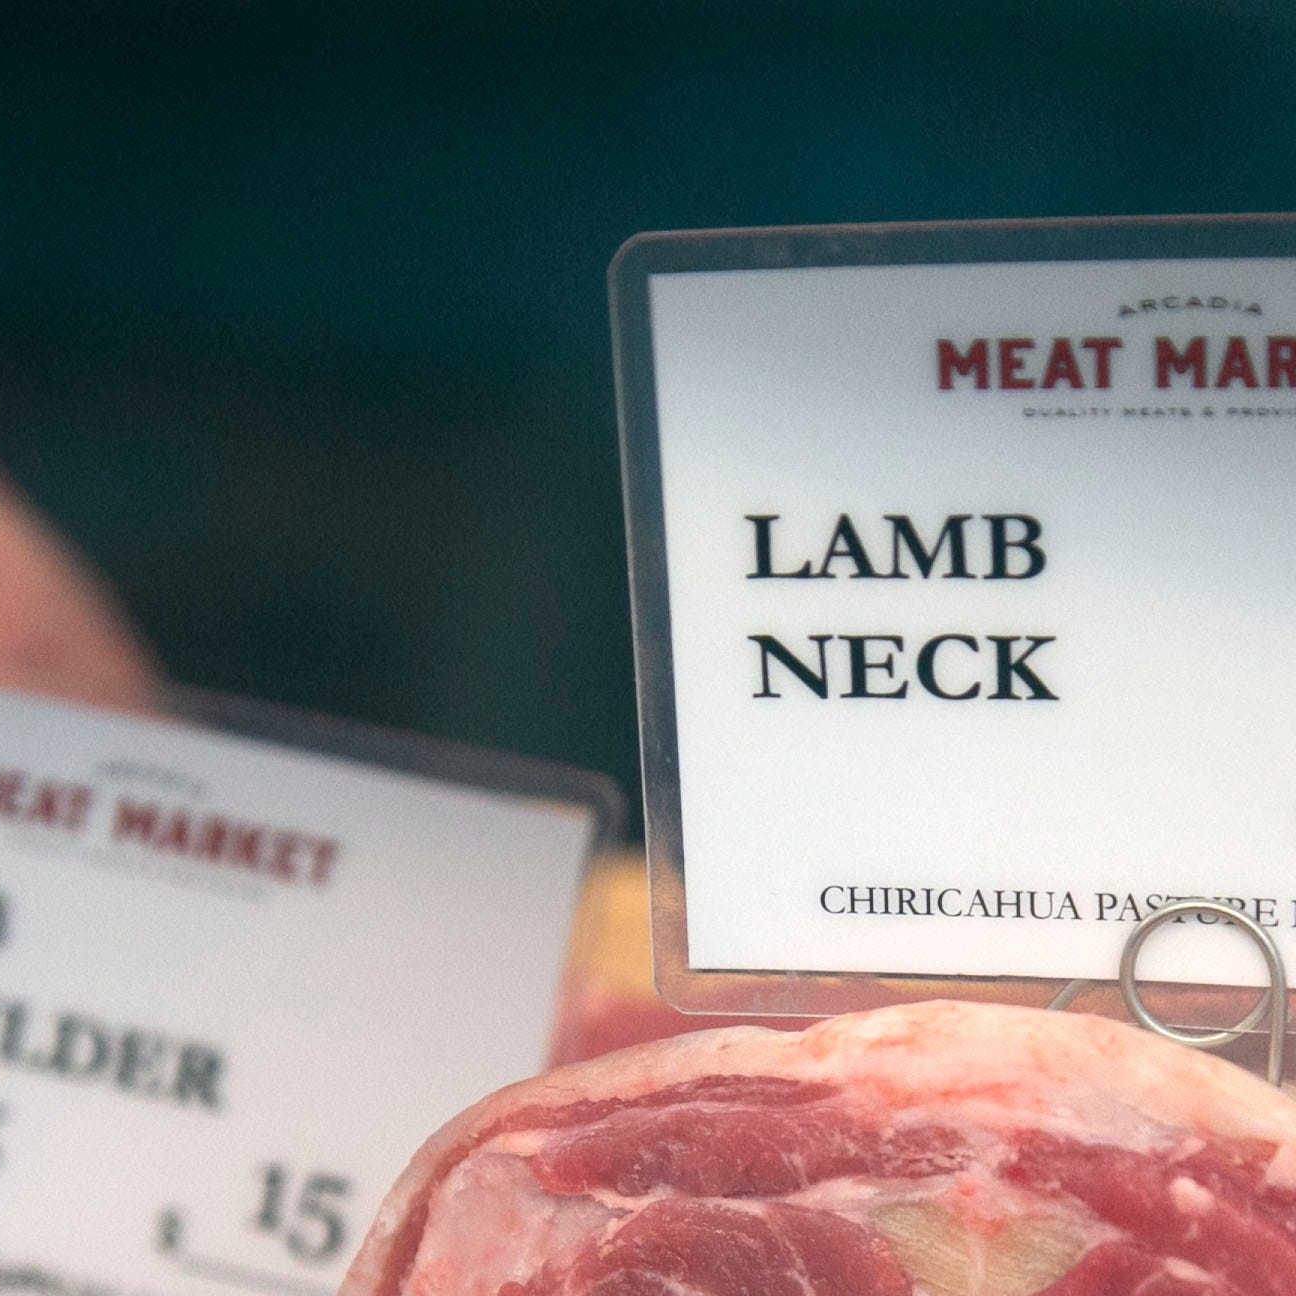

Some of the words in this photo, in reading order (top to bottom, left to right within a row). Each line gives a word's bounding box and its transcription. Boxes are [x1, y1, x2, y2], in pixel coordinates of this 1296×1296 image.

[1117, 295, 1264, 319] ARCADIA
[936, 336, 1124, 391] MEAT
[1022, 406, 1112, 419] QUALITY
[1121, 406, 1193, 419] MEATS
[744, 513, 1047, 581] LAMB
[747, 632, 1060, 702] NECK
[112, 796, 341, 886] MARKET
[819, 885, 1083, 921] CHIRICAHUA
[251, 1161, 356, 1263] 15
